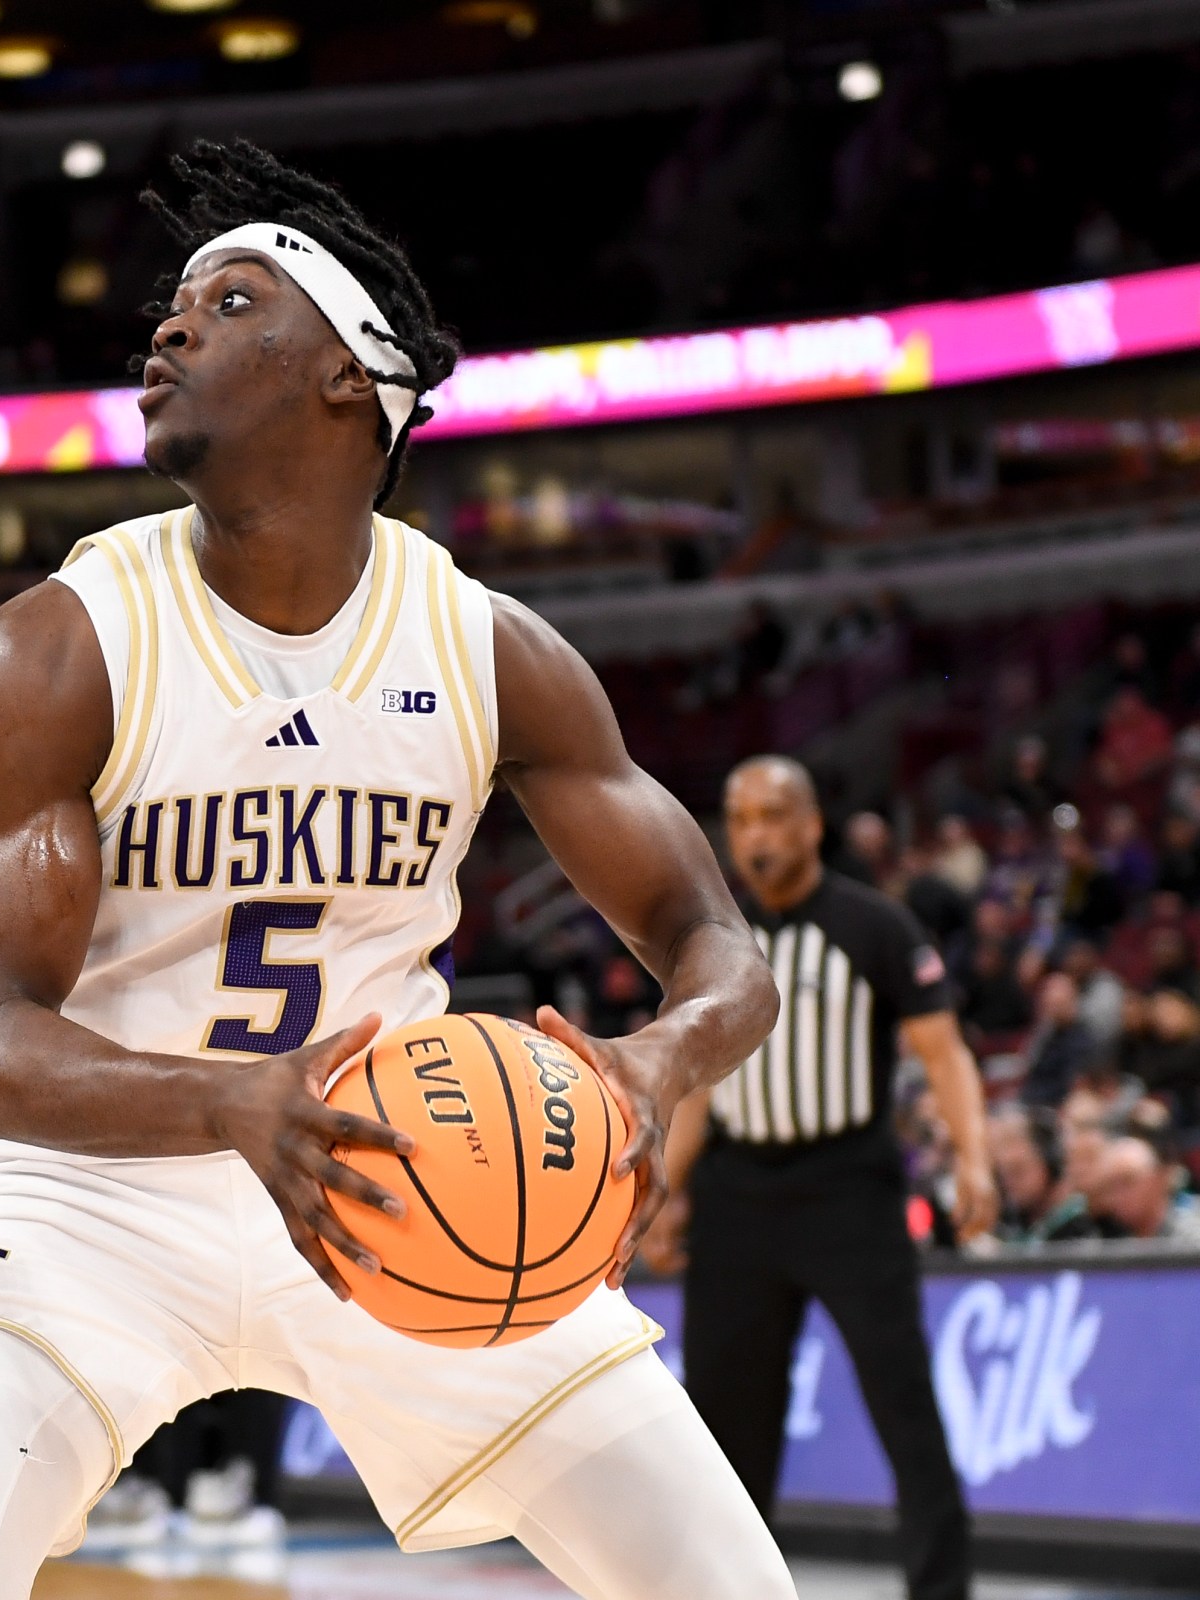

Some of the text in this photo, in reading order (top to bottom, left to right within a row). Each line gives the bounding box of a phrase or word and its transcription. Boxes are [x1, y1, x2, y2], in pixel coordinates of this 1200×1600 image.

[110, 784, 455, 892] HUSKIES
[199, 895, 335, 1062] 5
[403, 1036, 474, 1125] EVO
[463, 1127, 491, 1169] NXT
[931, 1270, 1102, 1487] Silk
